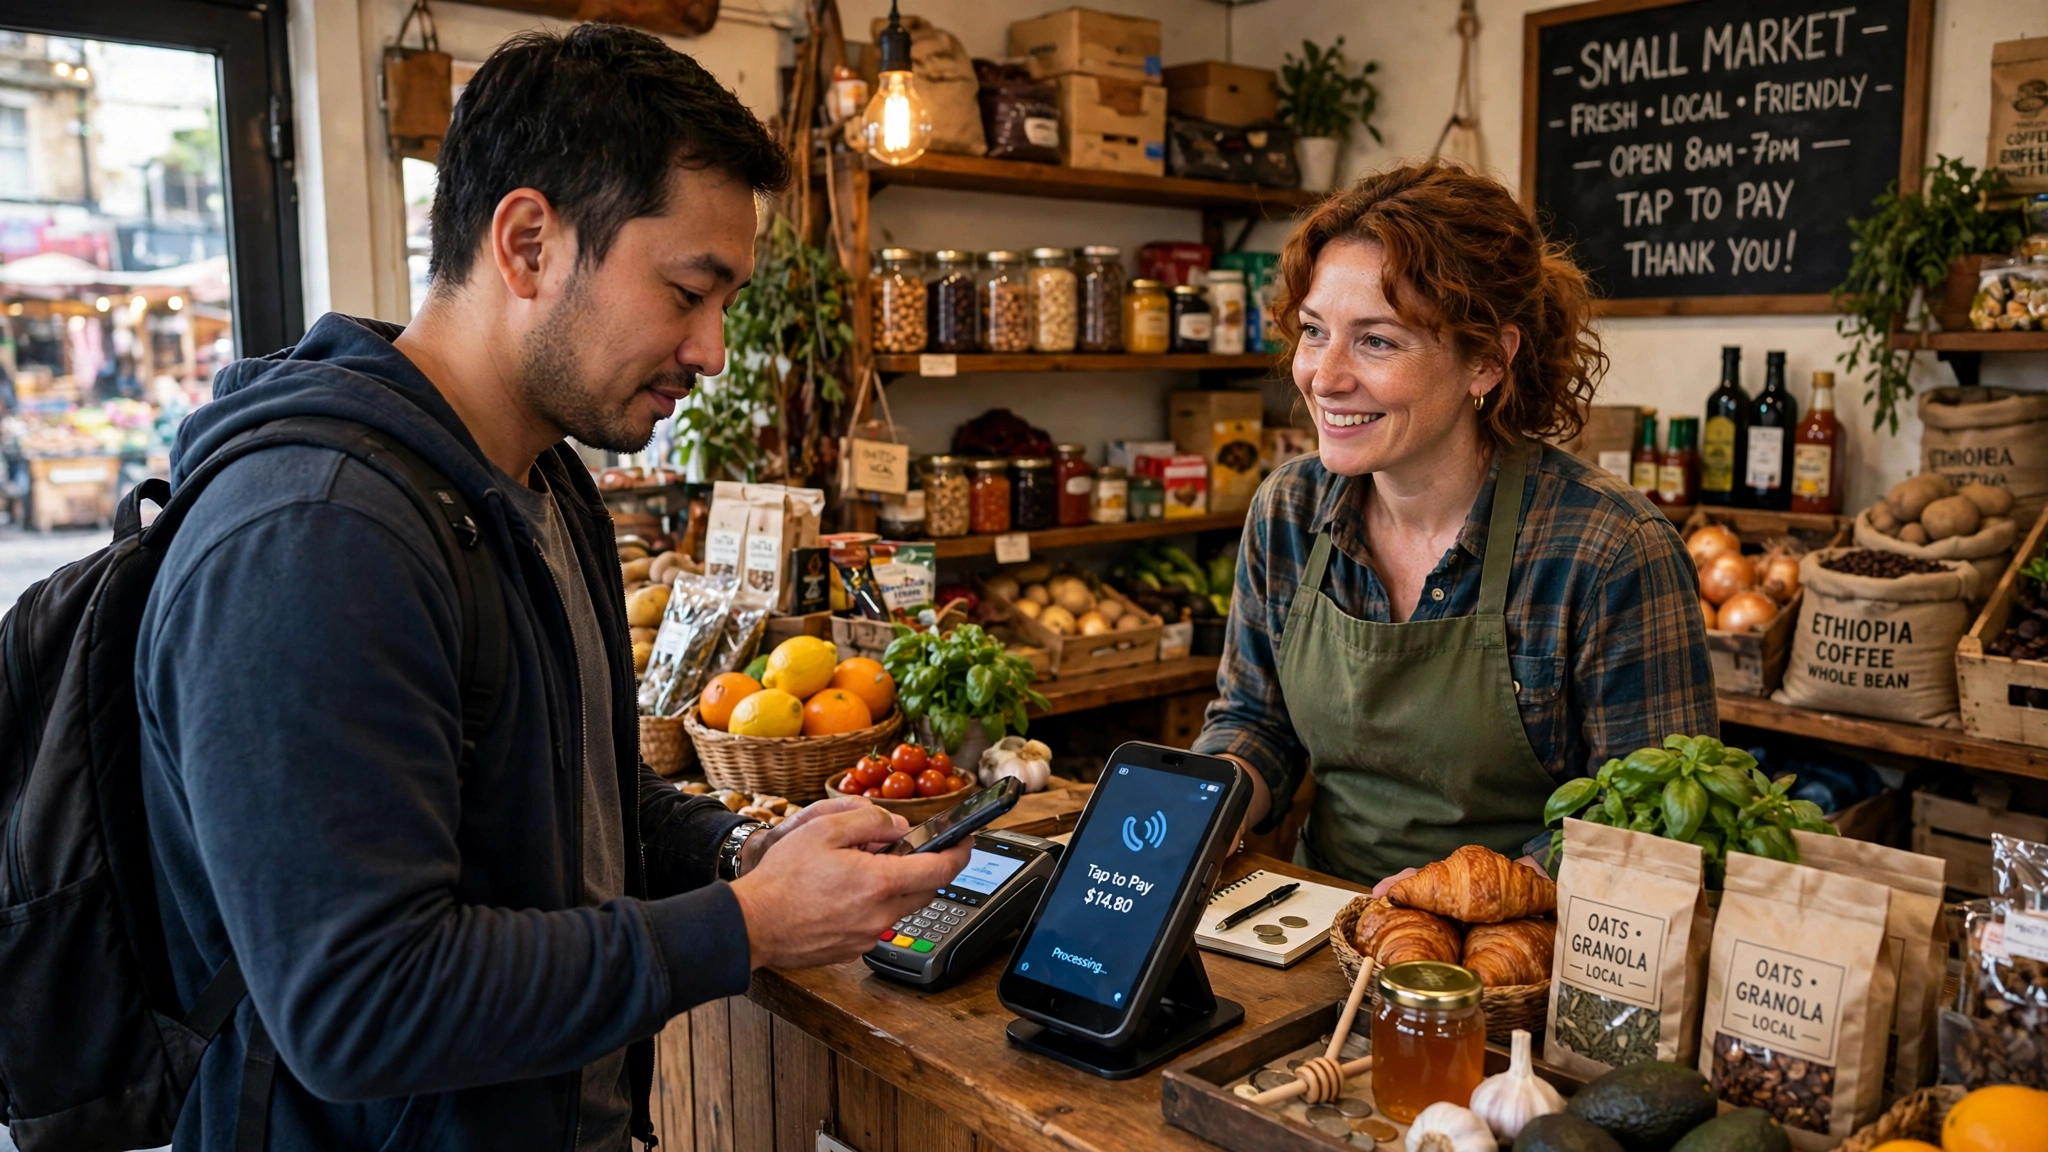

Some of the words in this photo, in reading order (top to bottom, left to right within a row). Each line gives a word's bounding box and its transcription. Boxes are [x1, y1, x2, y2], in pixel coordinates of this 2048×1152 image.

[1578, 31, 1689, 90] SMALL
[1702, 7, 1857, 73] MARKET
[1570, 100, 1639, 138] FRESH
[1661, 90, 1730, 126] LOCAL
[1754, 72, 1869, 116] FRIENDLY
[1609, 141, 1673, 178] OPEN
[1615, 187, 1675, 228] TAP
[1684, 186, 1723, 223] TO
[1736, 178, 1795, 221] PAY
[1624, 239, 1716, 278] THANK
[1727, 228, 1797, 276] YOU!
[1811, 611, 1913, 645] ETHIOPIA
[1816, 640, 1895, 669] COFFEE
[1807, 662, 1858, 687] WHOLE
[1863, 671, 1910, 690] BEAN
[1087, 863, 1111, 885] Tap
[1112, 871, 1127, 887] to
[1127, 874, 1155, 897] Pay
[1084, 887, 1134, 914] $14.80
[1588, 913, 1630, 940] OATS
[1571, 933, 1648, 973] GRANOLA
[1586, 963, 1625, 988] LOCAL
[1755, 958, 1804, 989] OATS
[1736, 980, 1824, 1025] GRANOLA
[1752, 1014, 1797, 1041] LOCAL
